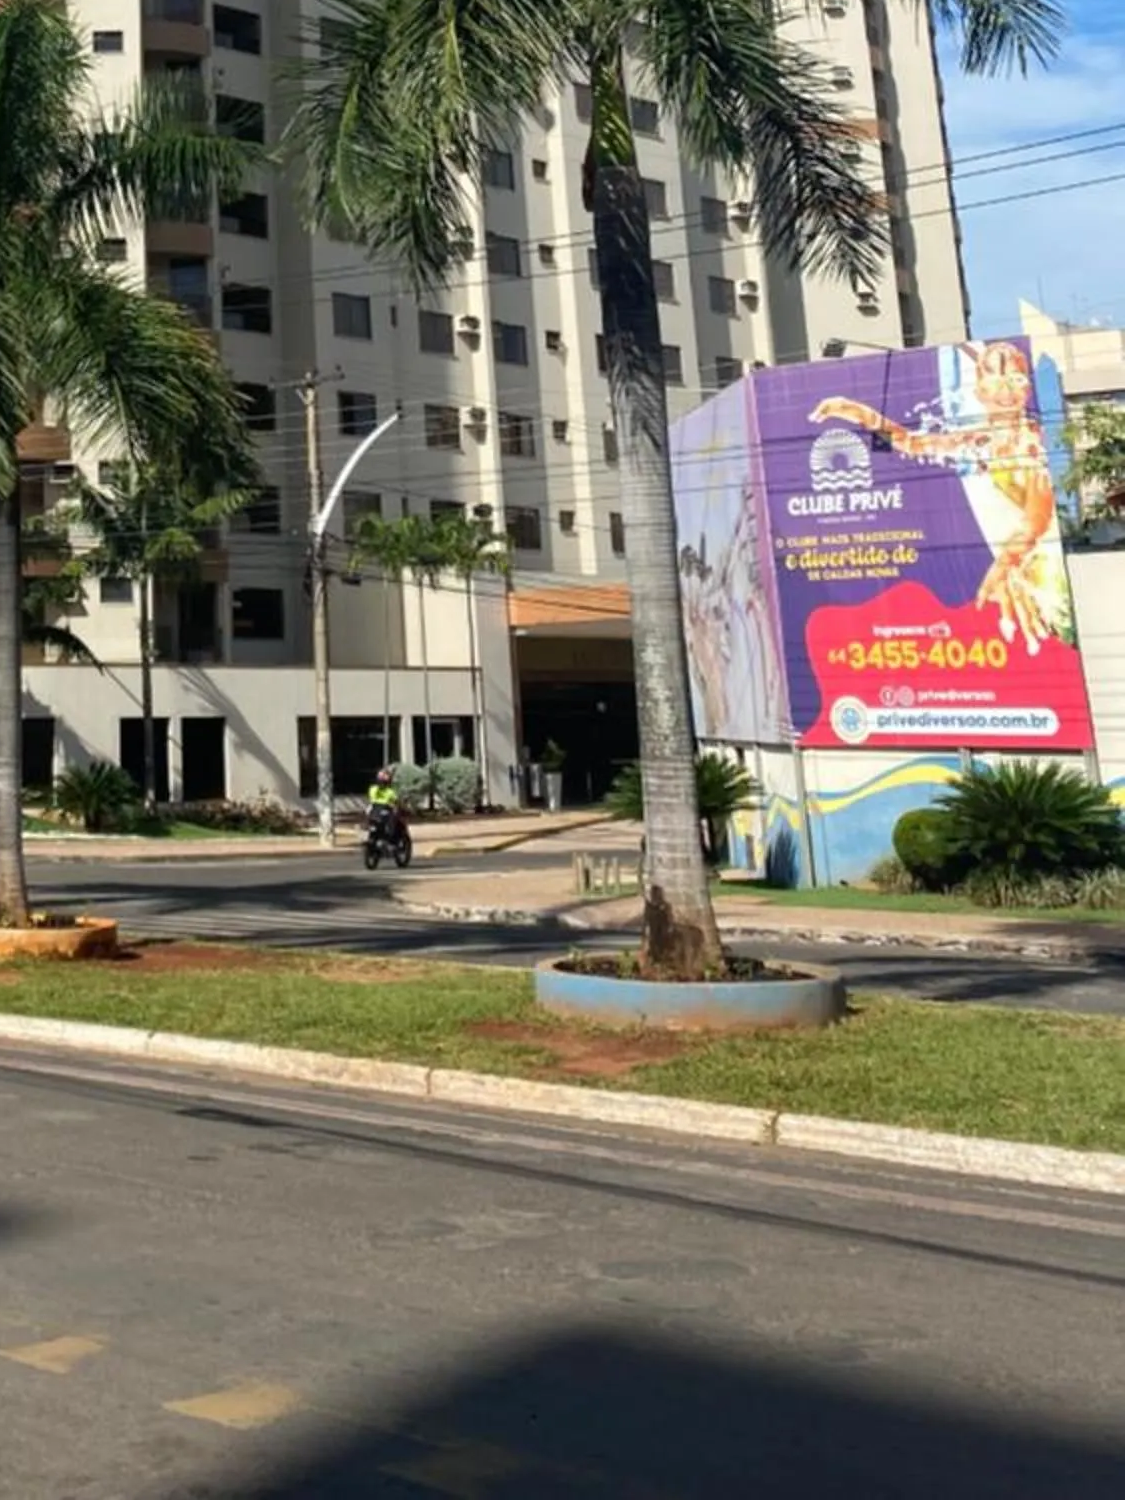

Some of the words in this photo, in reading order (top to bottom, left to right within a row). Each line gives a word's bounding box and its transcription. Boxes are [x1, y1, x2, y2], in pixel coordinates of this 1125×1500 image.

[787, 493, 844, 515] CLUBE
[849, 483, 903, 511] PRIVÉ
[786, 553, 797, 570] e
[800, 546, 889, 569] divertido
[892, 544, 919, 564] de
[828, 648, 847, 664] 64
[848, 638, 1008, 669] 3455-4040
[877, 710, 1048, 729] privediversao.com.br
